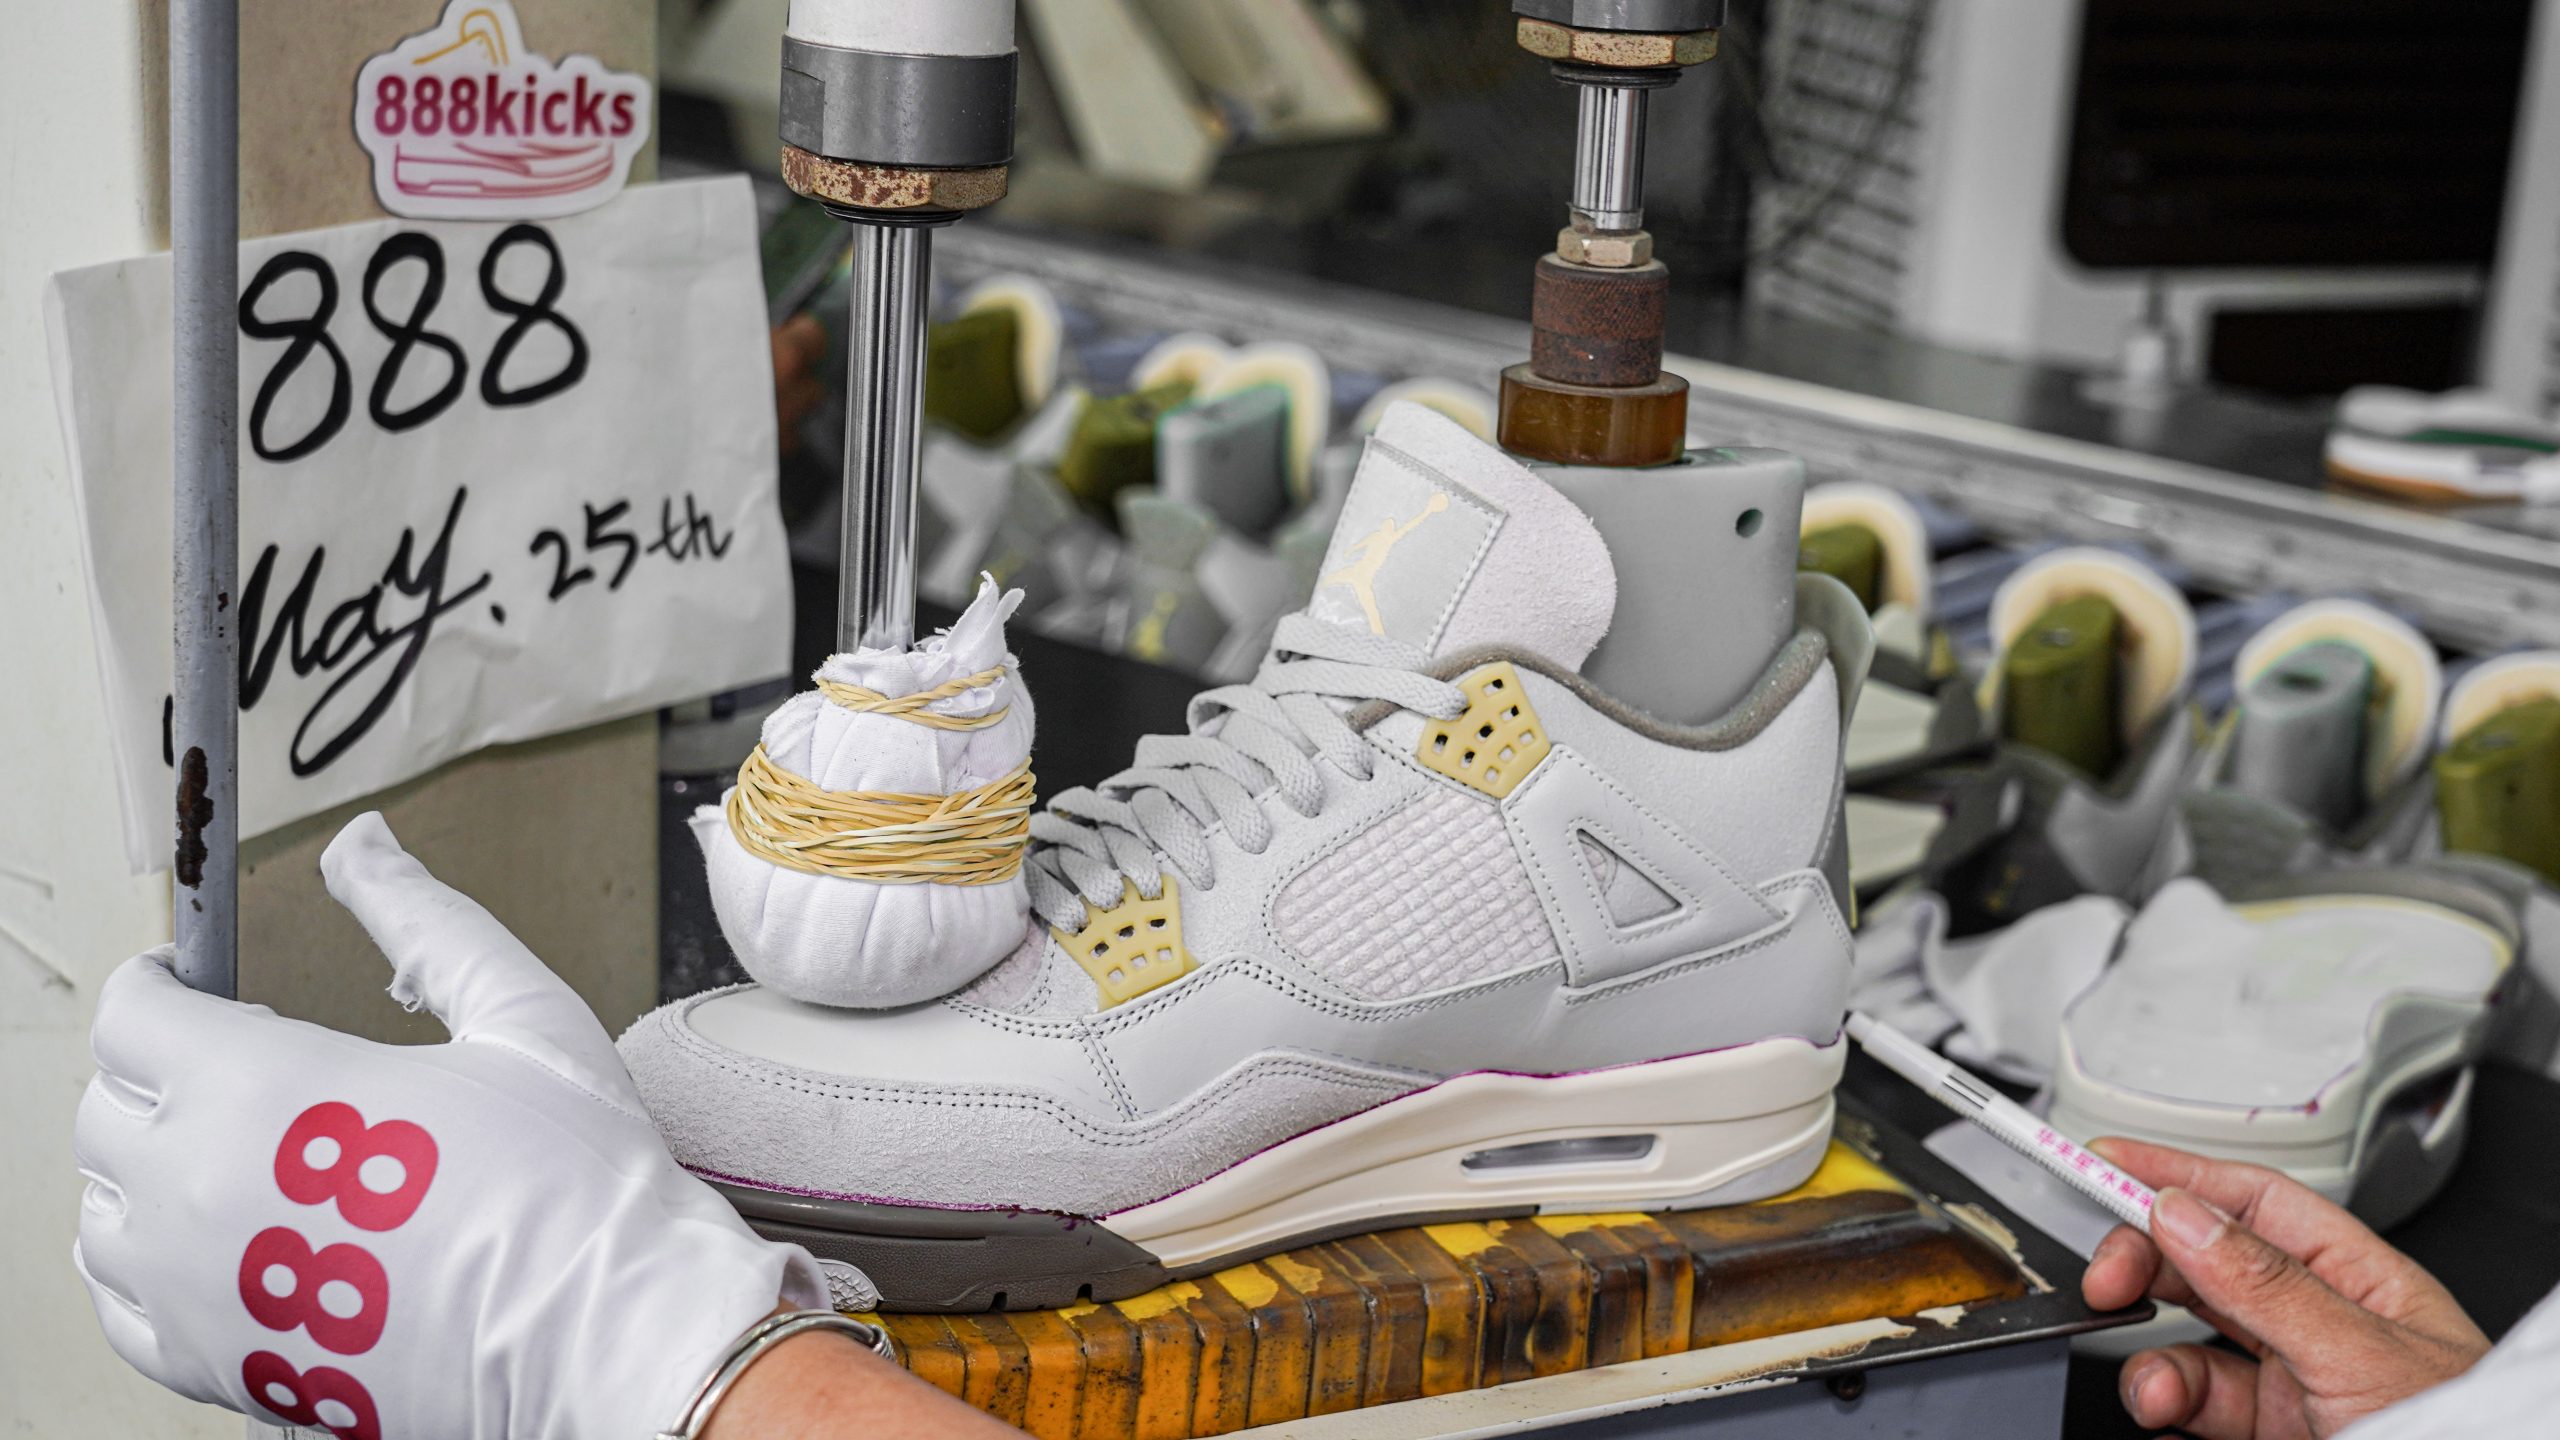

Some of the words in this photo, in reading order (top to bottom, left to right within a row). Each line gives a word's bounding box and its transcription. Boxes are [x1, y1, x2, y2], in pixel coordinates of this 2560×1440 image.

[374, 74, 635, 136] 888kicks
[239, 223, 589, 463] 888
[529, 491, 734, 602] 25th
[238, 1100, 439, 1440] 888
